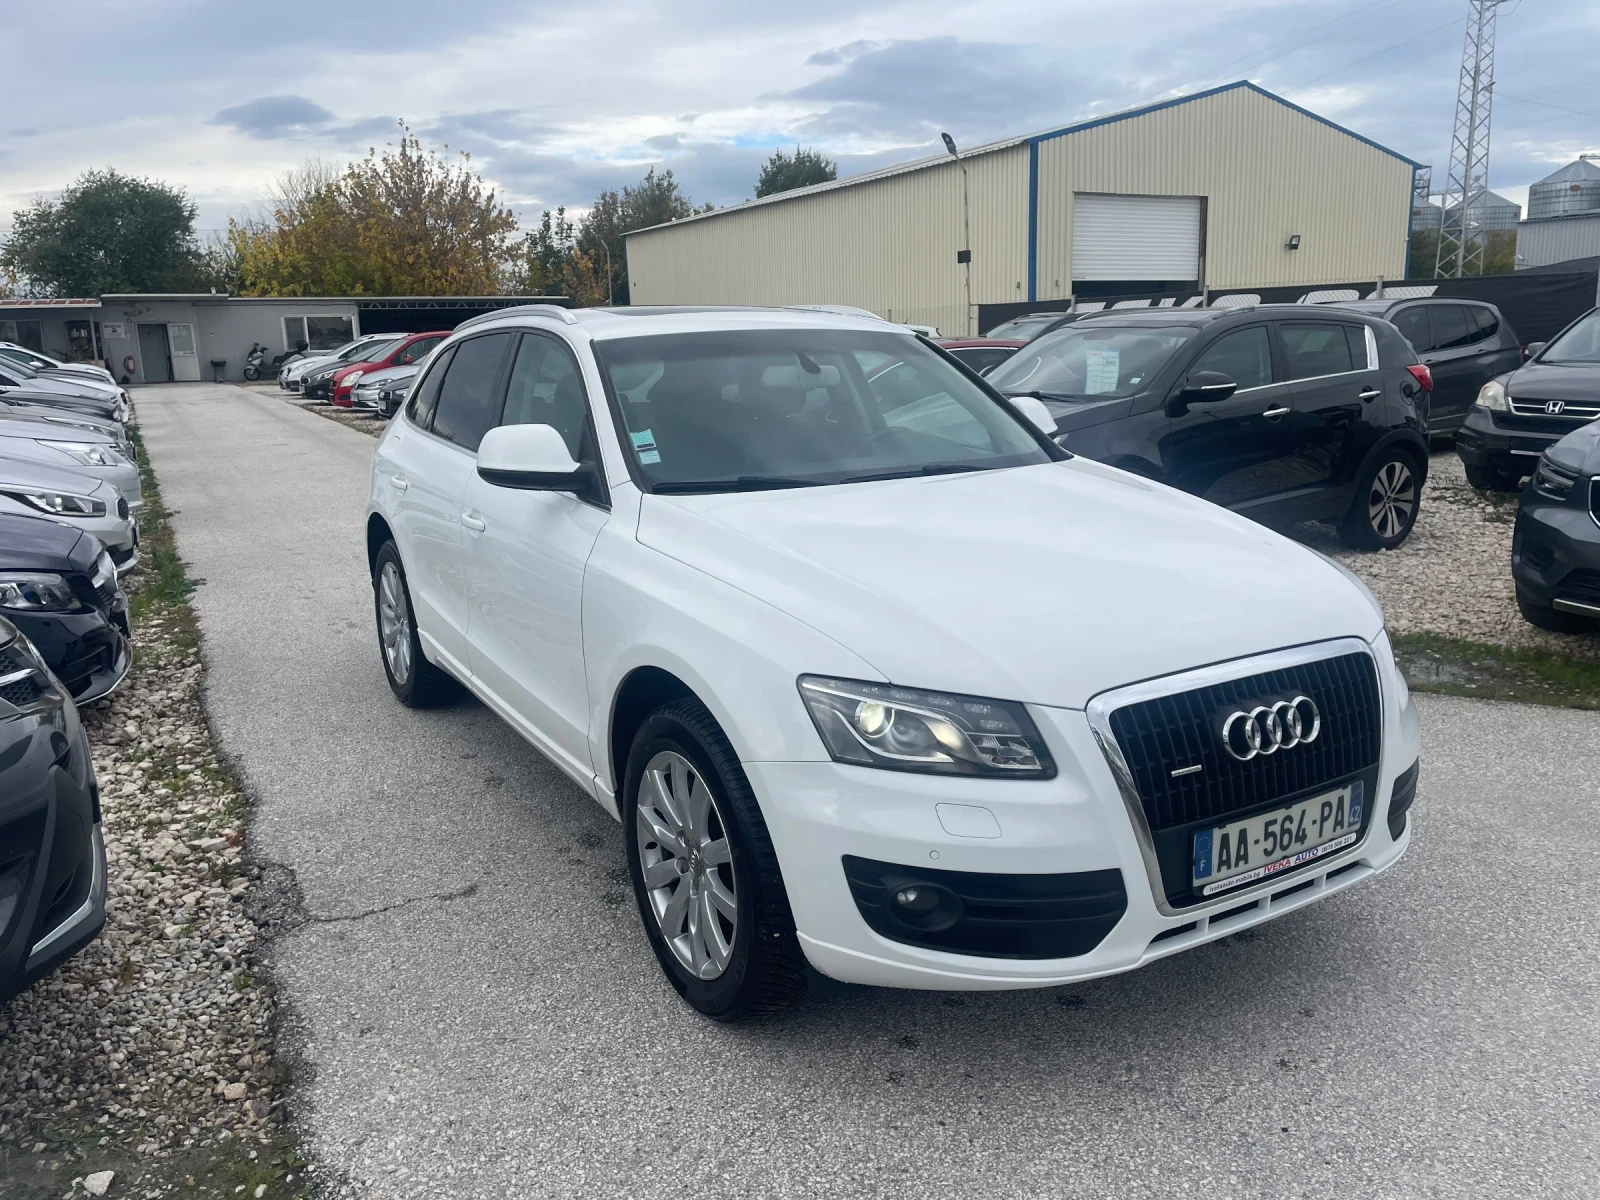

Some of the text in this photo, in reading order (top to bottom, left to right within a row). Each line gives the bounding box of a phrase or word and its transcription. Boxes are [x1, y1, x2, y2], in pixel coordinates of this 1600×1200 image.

[1216, 795, 1345, 873] AA-564-PA
[1200, 859, 1206, 871] F
[1263, 858, 1291, 873] IVEKA
[1294, 848, 1319, 863] AUTO
